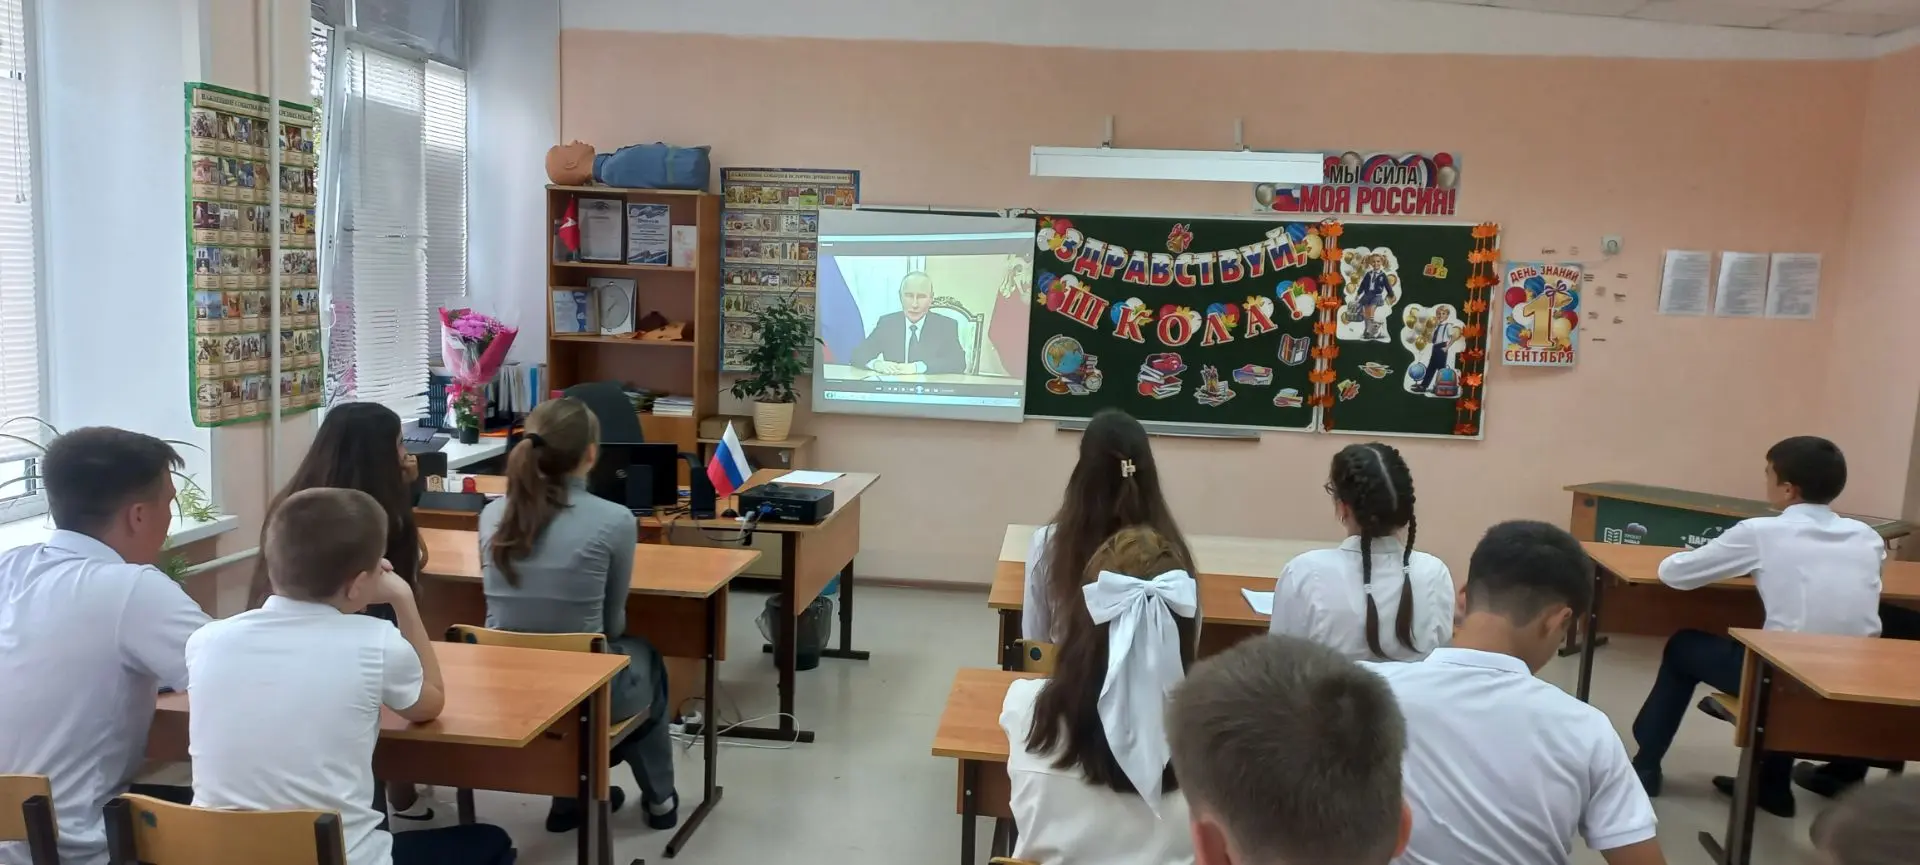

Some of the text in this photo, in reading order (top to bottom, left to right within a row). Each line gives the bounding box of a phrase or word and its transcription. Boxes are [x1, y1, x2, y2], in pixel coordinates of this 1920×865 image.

[1329, 165, 1422, 187] МЫ СИЛА,
[1300, 184, 1456, 215] МОЯ РОССИЯ!
[1054, 226, 1308, 287] ЗДРАВСТВУЙ,
[1510, 267, 1537, 283] ДЕНЬ
[1523, 292, 1556, 348] 1
[1505, 350, 1574, 363] СЕНТЯБРЯ
